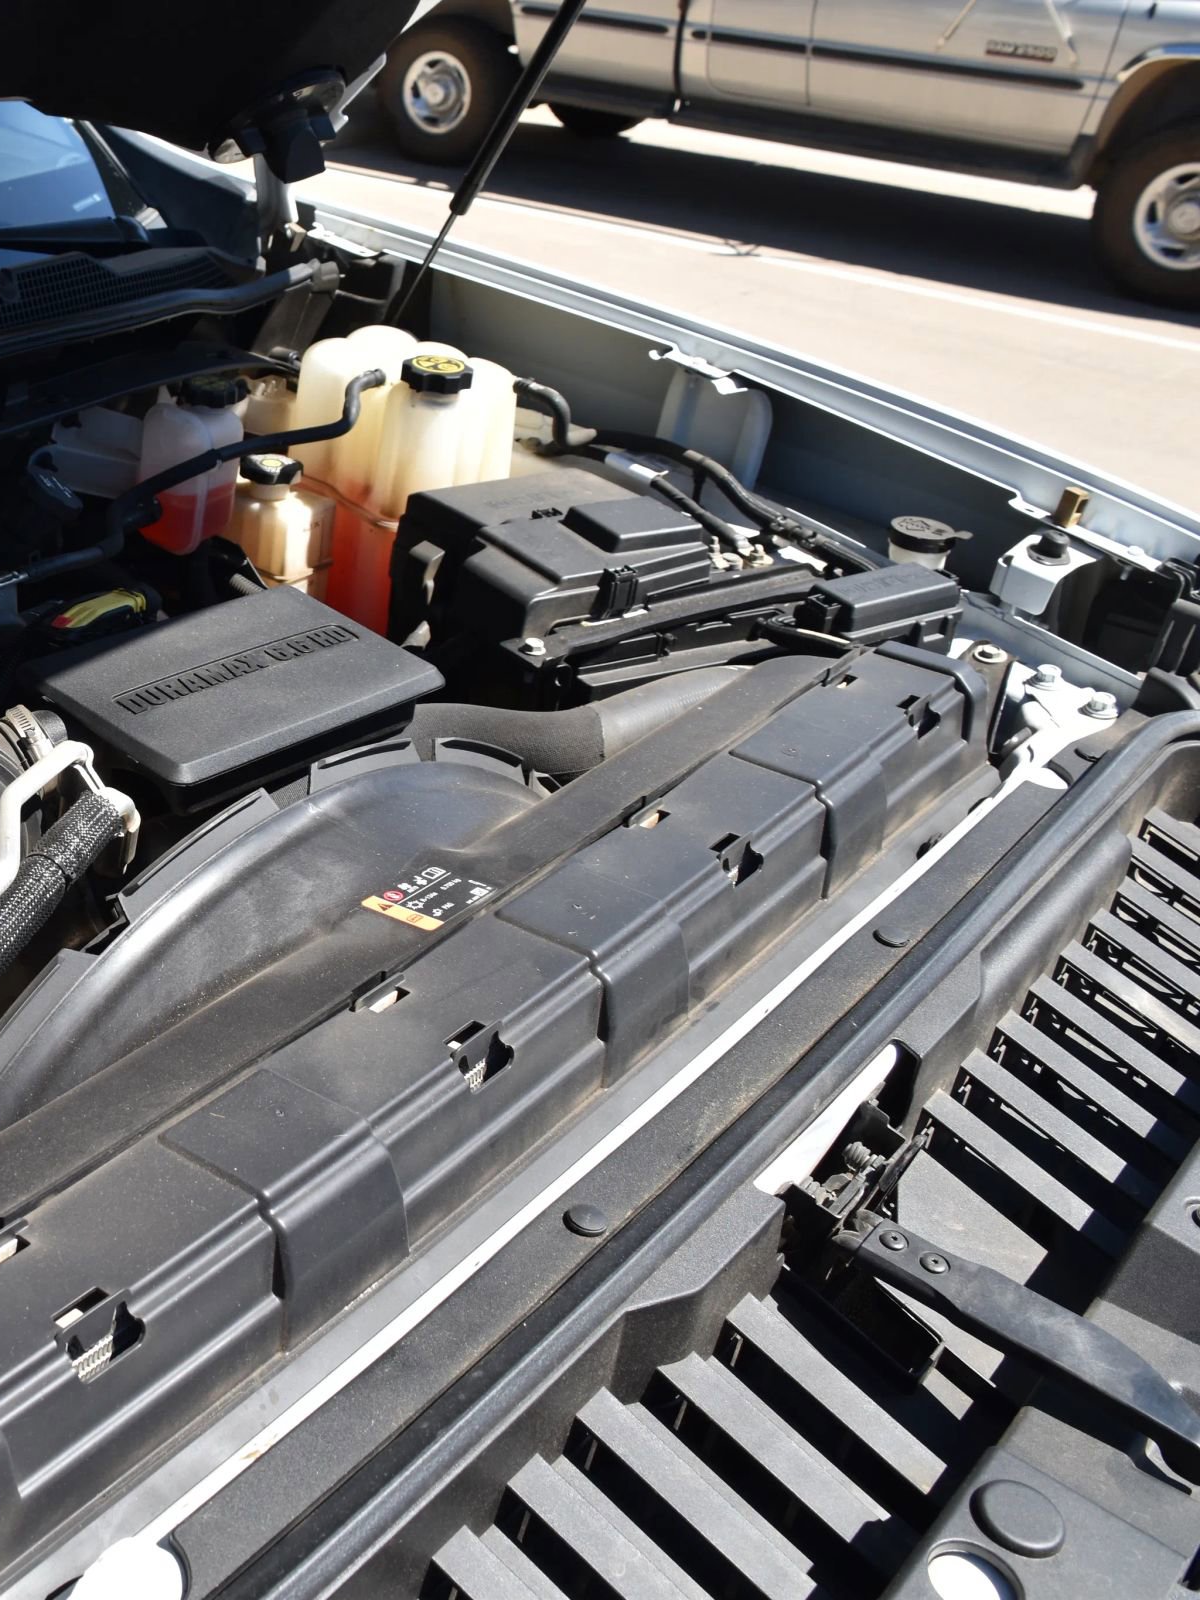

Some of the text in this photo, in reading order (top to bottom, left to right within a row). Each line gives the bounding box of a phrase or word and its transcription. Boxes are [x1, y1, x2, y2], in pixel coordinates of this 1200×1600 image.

[116, 626, 354, 715] DURAMAX 6.6 HD
